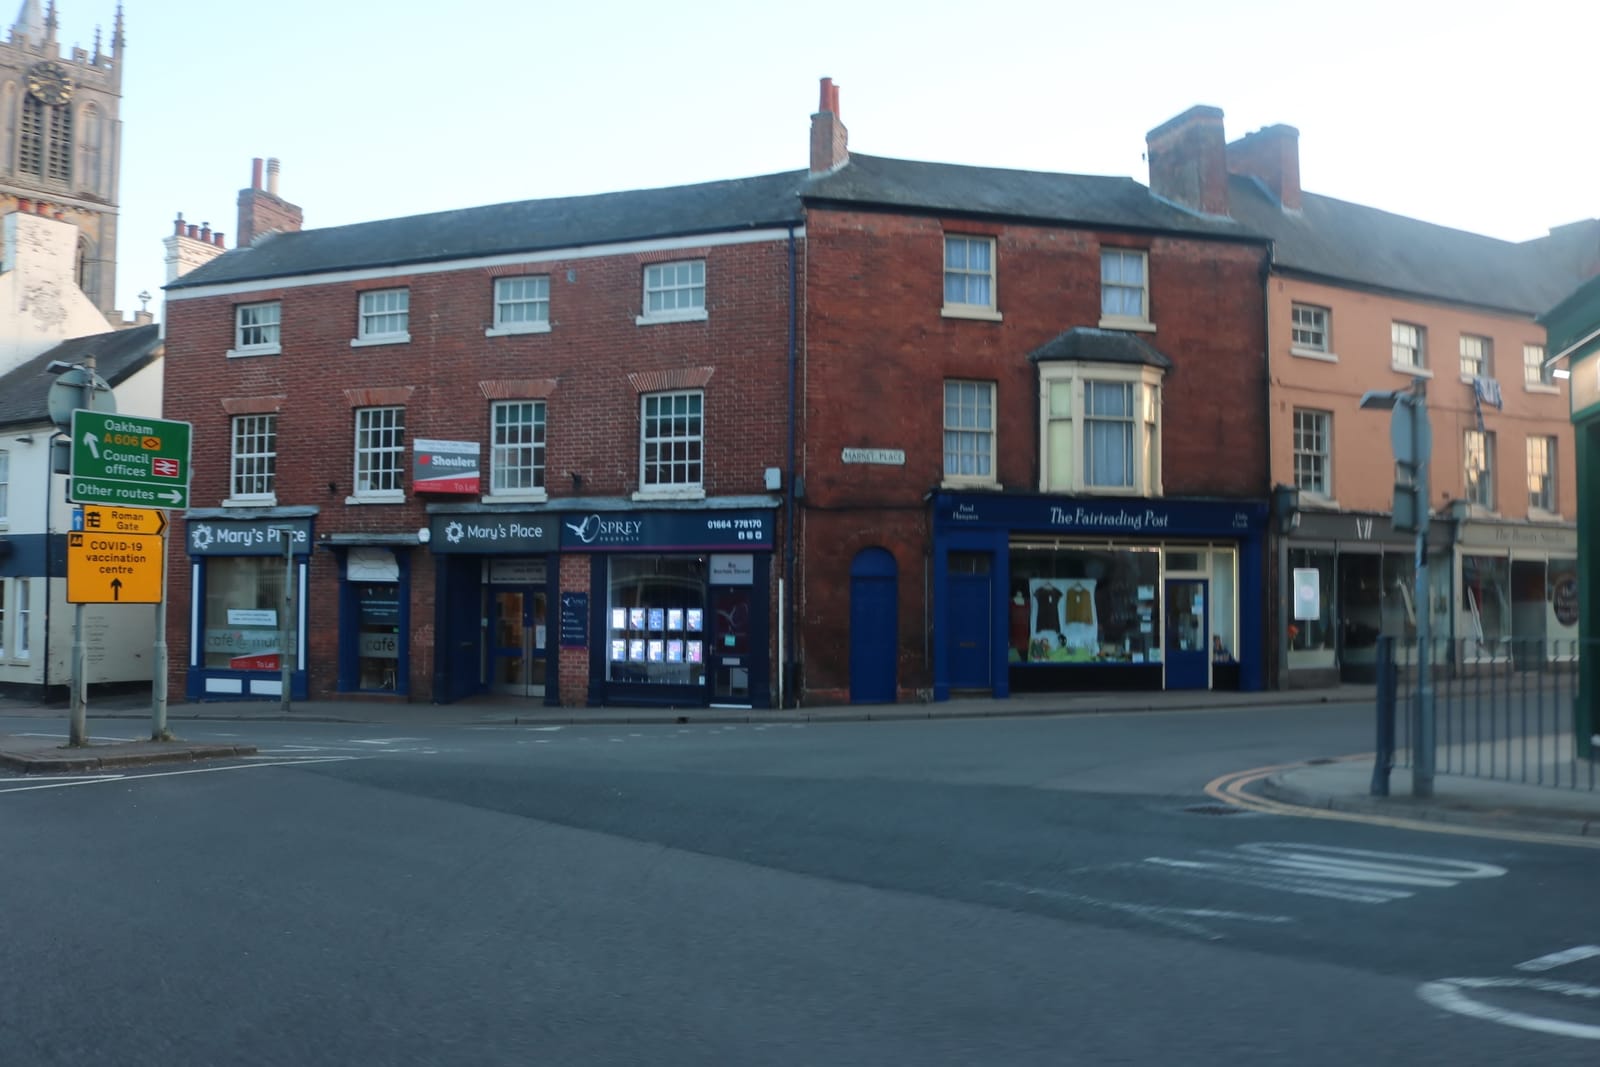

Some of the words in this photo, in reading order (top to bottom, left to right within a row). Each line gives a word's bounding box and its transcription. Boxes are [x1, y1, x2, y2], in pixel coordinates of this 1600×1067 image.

[104, 419, 154, 435] Oakham
[103, 449, 150, 465] Council
[432, 455, 476, 468] Shoulers
[844, 451, 874, 461] MARKET
[879, 452, 903, 462] PLACE
[105, 463, 147, 477] offices
[76, 483, 112, 497] Other
[116, 486, 155, 500] routes
[111, 511, 143, 521] Roman
[1051, 506, 1073, 524] The
[1075, 507, 1142, 530] Fairtrading
[1144, 509, 1168, 527] Post
[116, 521, 139, 531] Gate
[467, 523, 507, 540] Mary's
[510, 523, 542, 538] Place
[216, 528, 264, 546] Mary's
[90, 541, 143, 551] COVID-19
[86, 554, 146, 563] vaccination
[99, 566, 134, 574] centre
